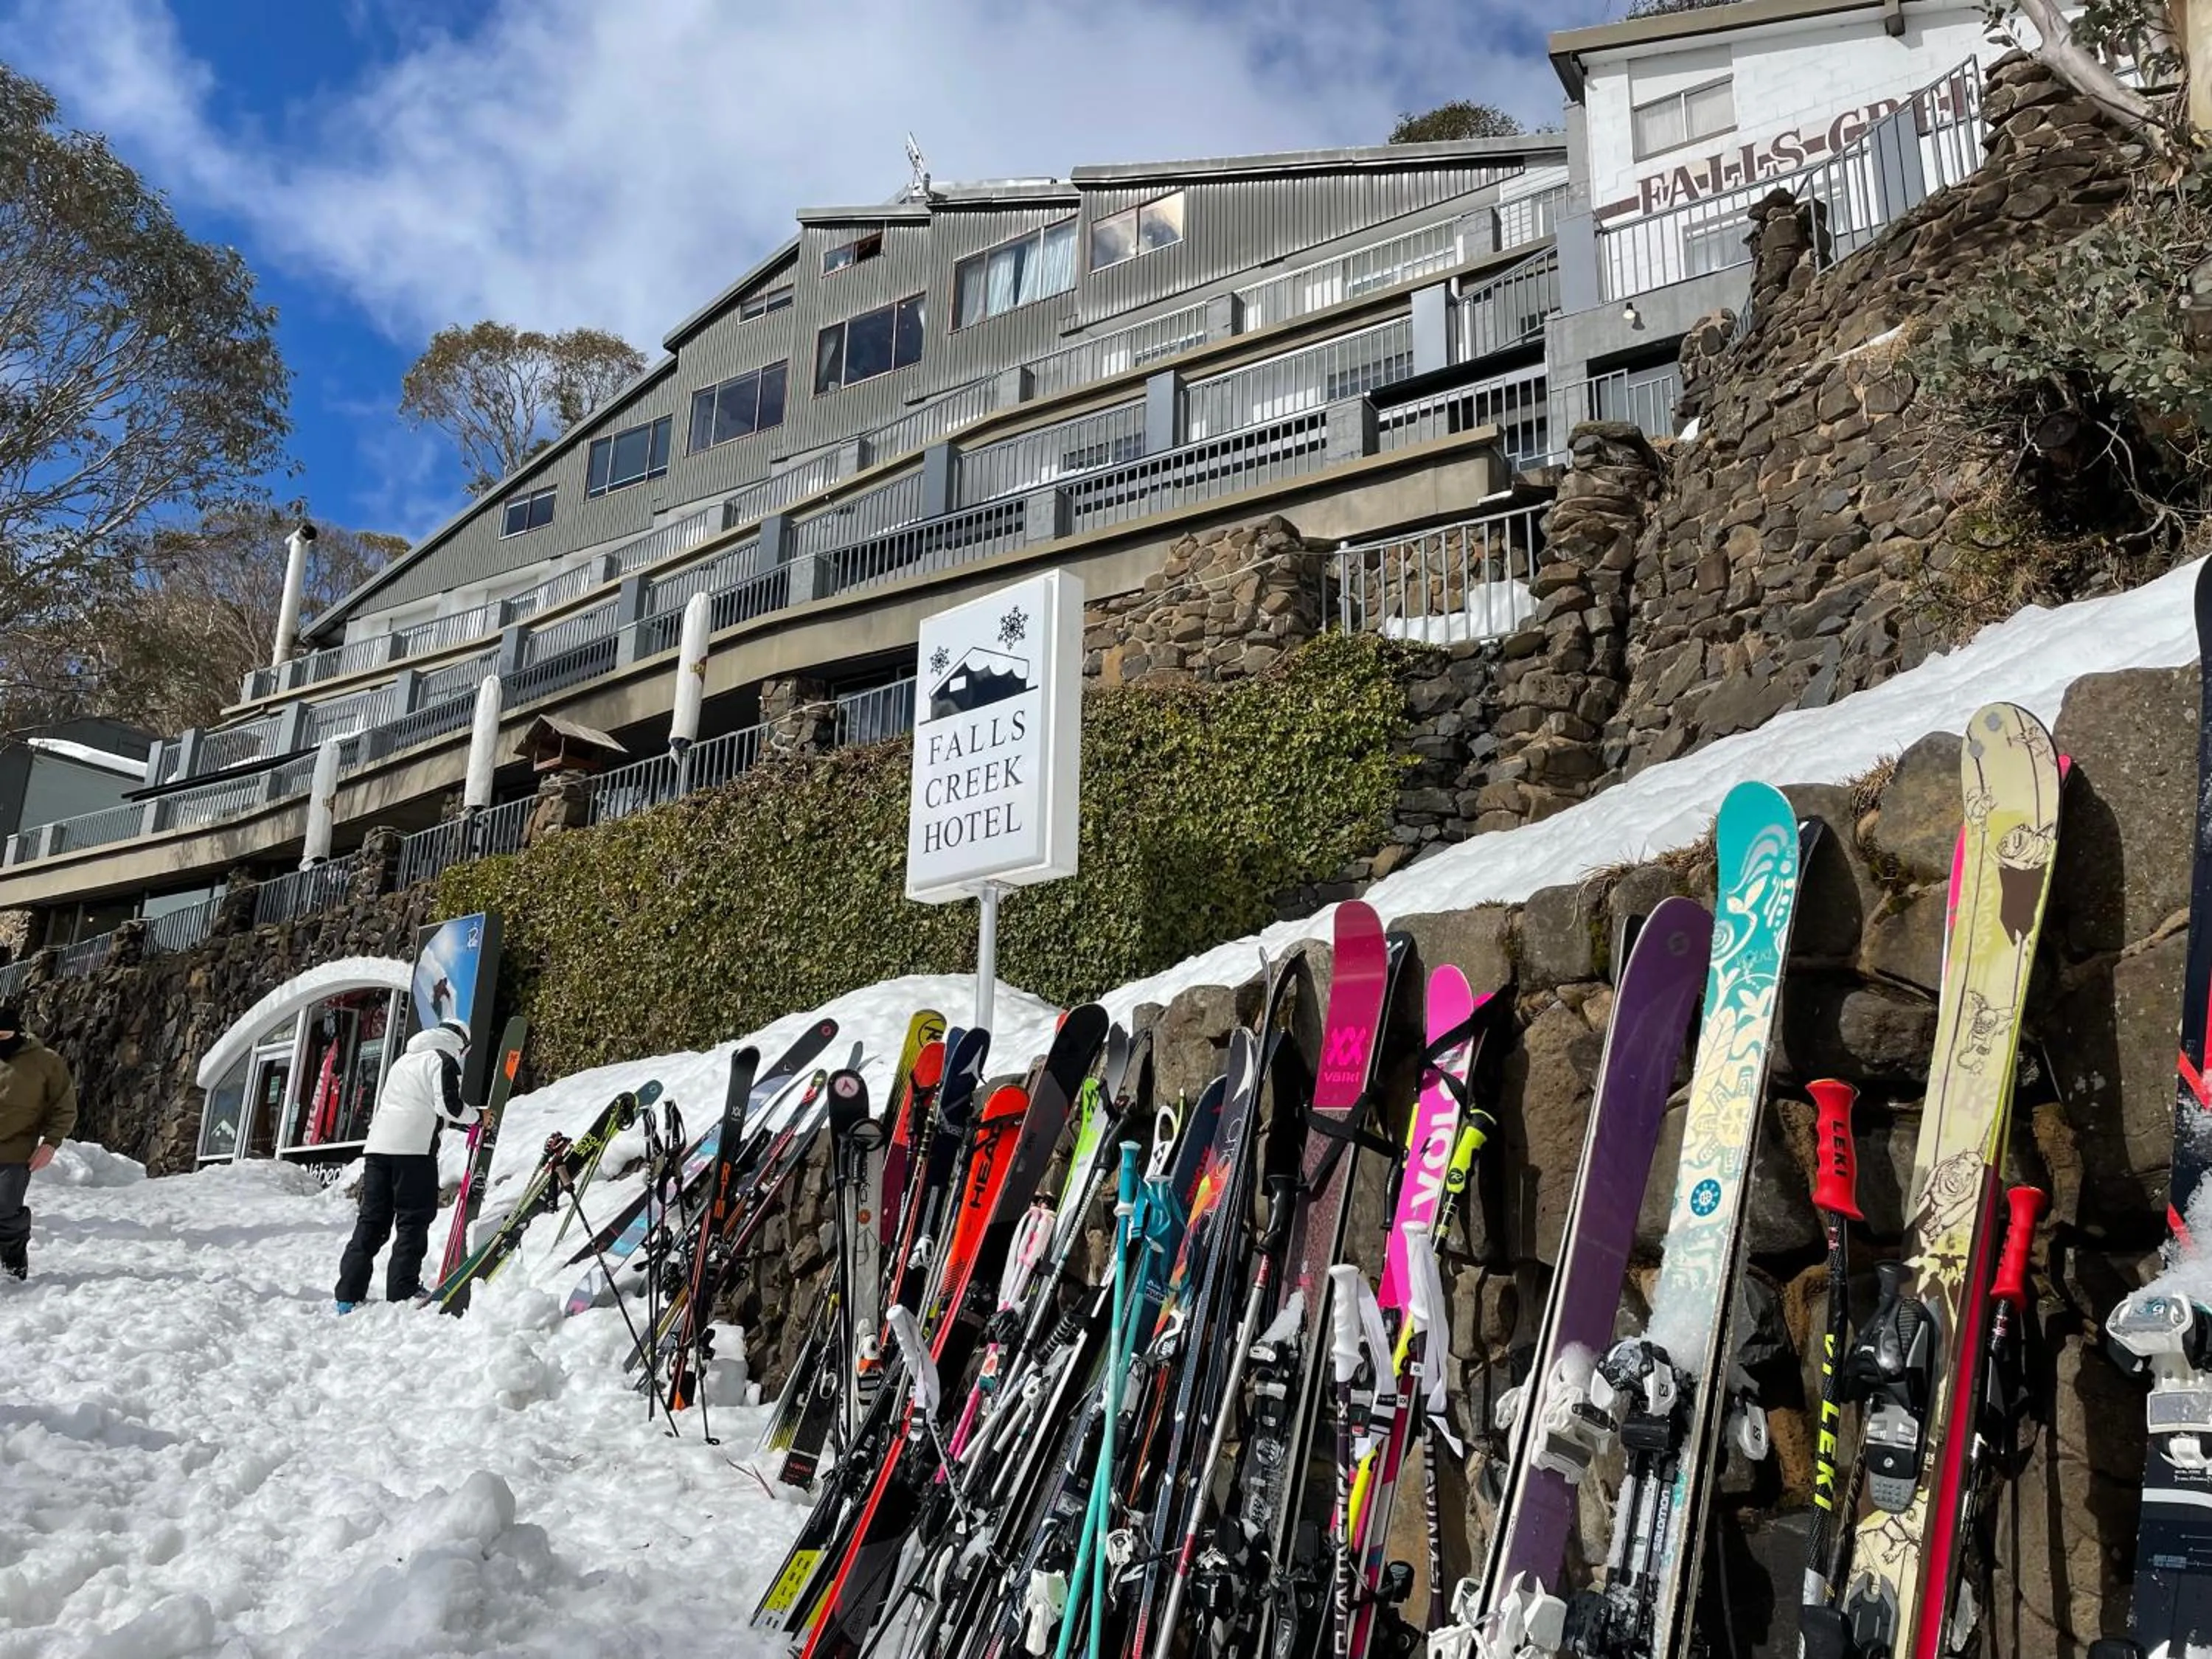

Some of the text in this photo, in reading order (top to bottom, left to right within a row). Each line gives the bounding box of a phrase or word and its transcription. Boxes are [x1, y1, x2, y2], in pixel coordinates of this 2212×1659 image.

[1637, 129, 1806, 215] FALLS
[928, 709, 1026, 765] FALLS
[925, 754, 1024, 809] CREEK
[923, 802, 1022, 854] HOTEL
[1832, 1120, 1848, 1177] LEKI
[1815, 1399, 1840, 1511] LEKI
